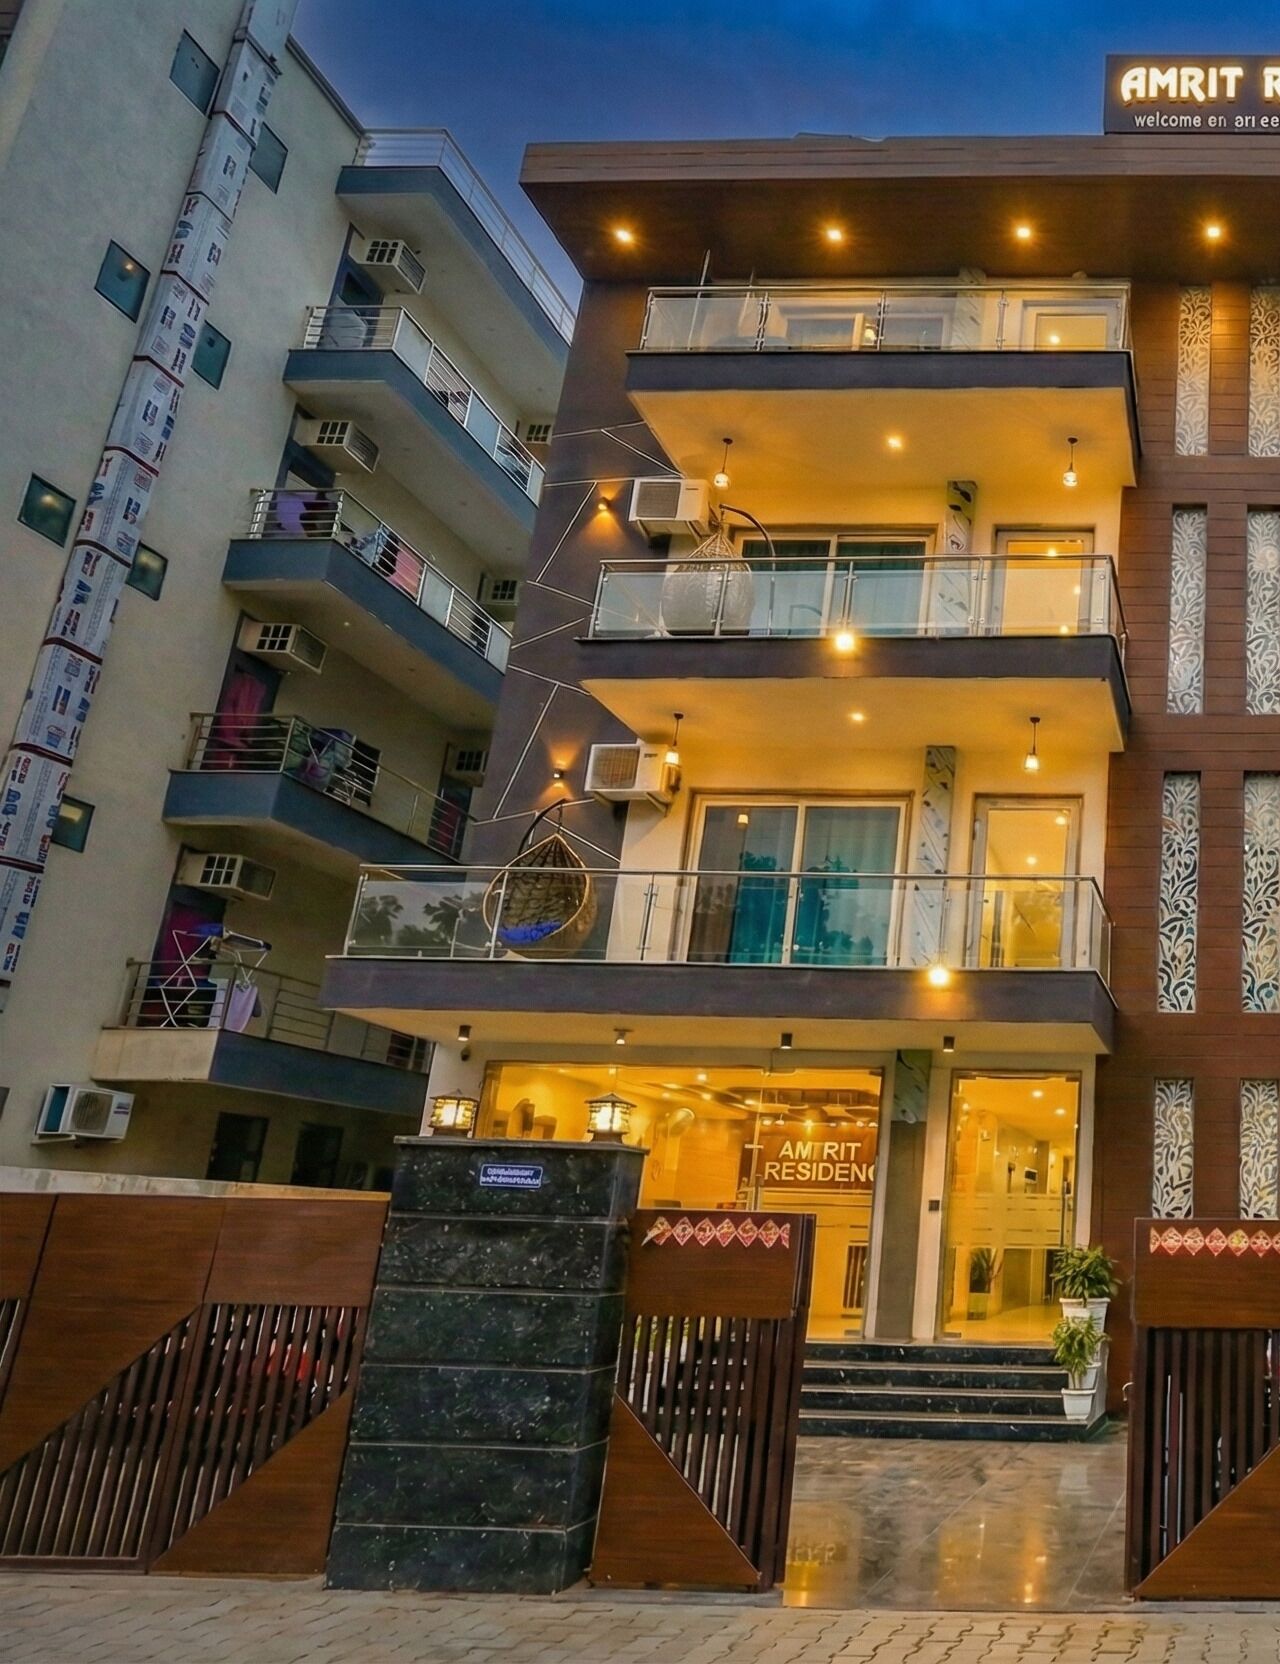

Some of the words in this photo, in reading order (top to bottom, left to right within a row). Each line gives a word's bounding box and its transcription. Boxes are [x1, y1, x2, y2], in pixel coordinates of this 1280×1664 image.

[1121, 66, 1243, 102] AMRIT
[1134, 111, 1202, 128] welcome
[778, 1140, 862, 1160] AMRIT
